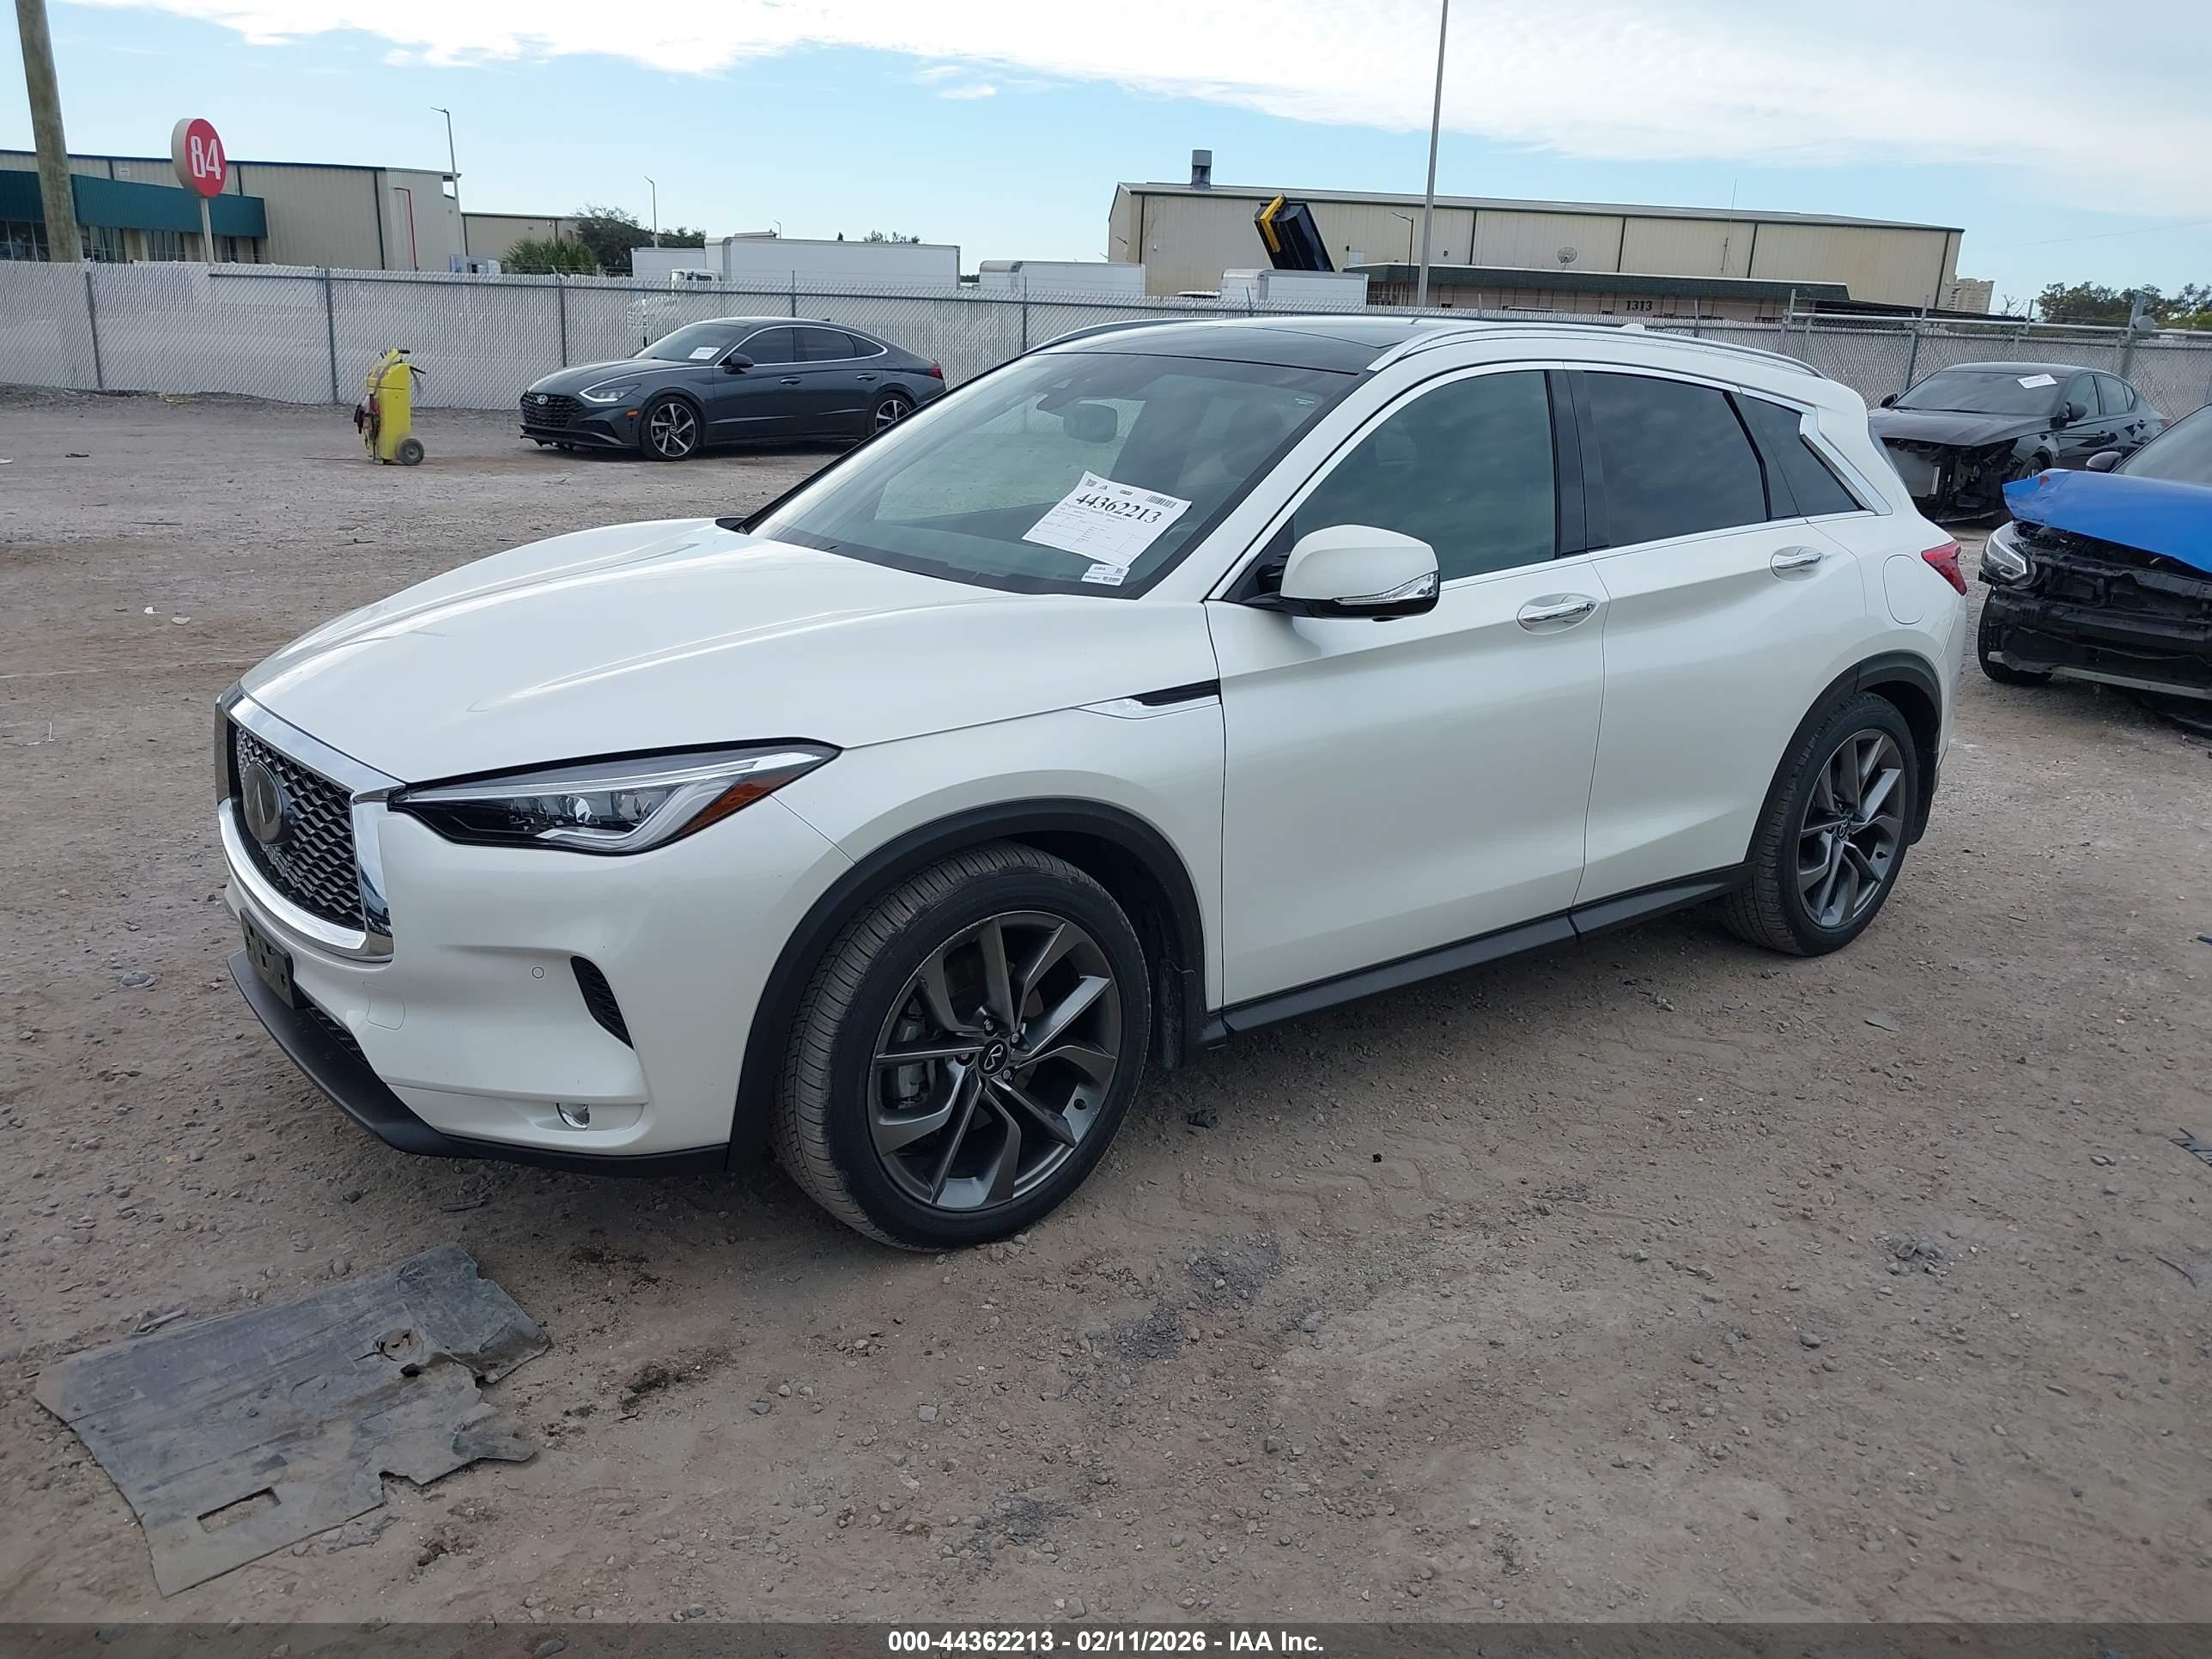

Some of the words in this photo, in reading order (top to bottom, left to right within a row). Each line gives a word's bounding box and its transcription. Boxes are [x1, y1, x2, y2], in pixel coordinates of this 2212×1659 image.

[191, 136, 222, 180] 84
[1626, 301, 1652, 311] 1313
[1076, 493, 1162, 524] 44362213
